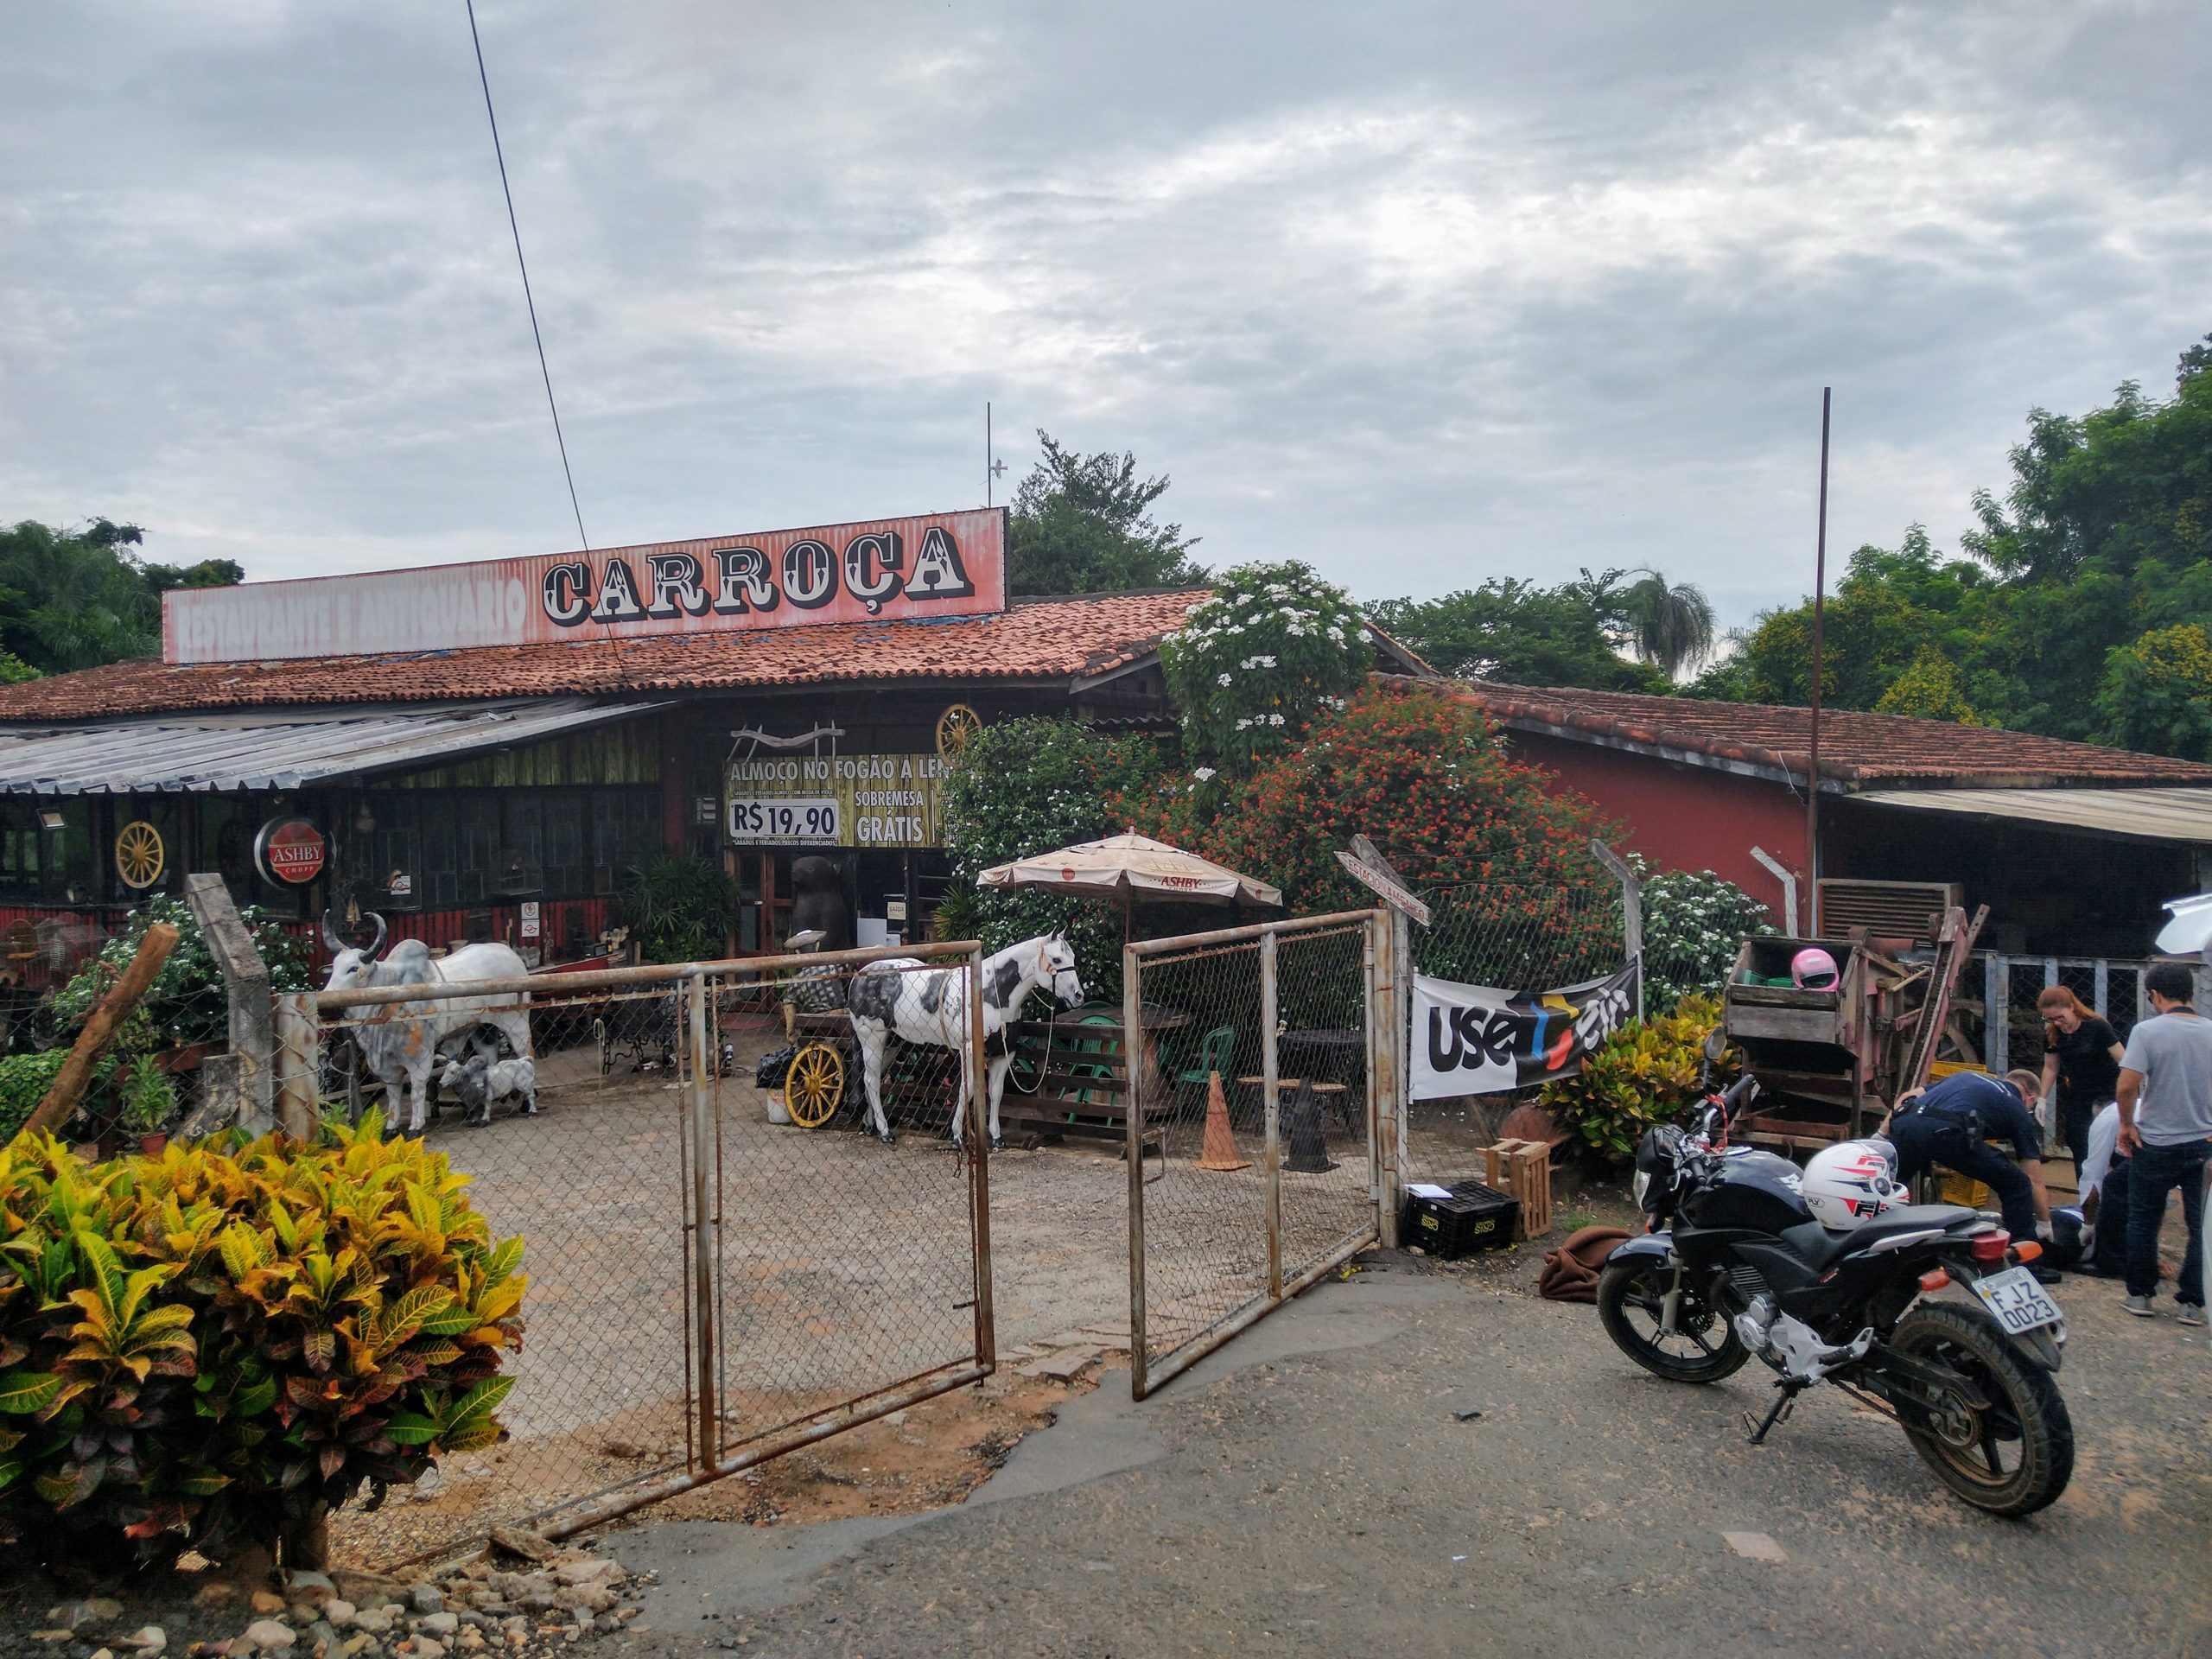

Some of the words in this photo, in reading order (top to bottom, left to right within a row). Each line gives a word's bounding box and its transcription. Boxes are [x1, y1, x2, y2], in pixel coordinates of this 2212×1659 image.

[543, 526, 975, 626] CARROÇA
[730, 761, 798, 785] ALMOÇO
[804, 760, 830, 780] NO
[835, 753, 895, 779] FOGÃO
[900, 759, 913, 779] A
[855, 790, 924, 807] SOBREMESA
[734, 801, 763, 833] R$
[768, 807, 835, 836] 19,90
[857, 809, 923, 842] GRÁTIS
[274, 846, 321, 862] ASHBY
[1161, 876, 1202, 889] ASHBY
[1421, 1217, 1439, 1231] CRIS
[1474, 1222, 1496, 1235] CRIS
[2003, 1299, 2055, 1329] 0023
